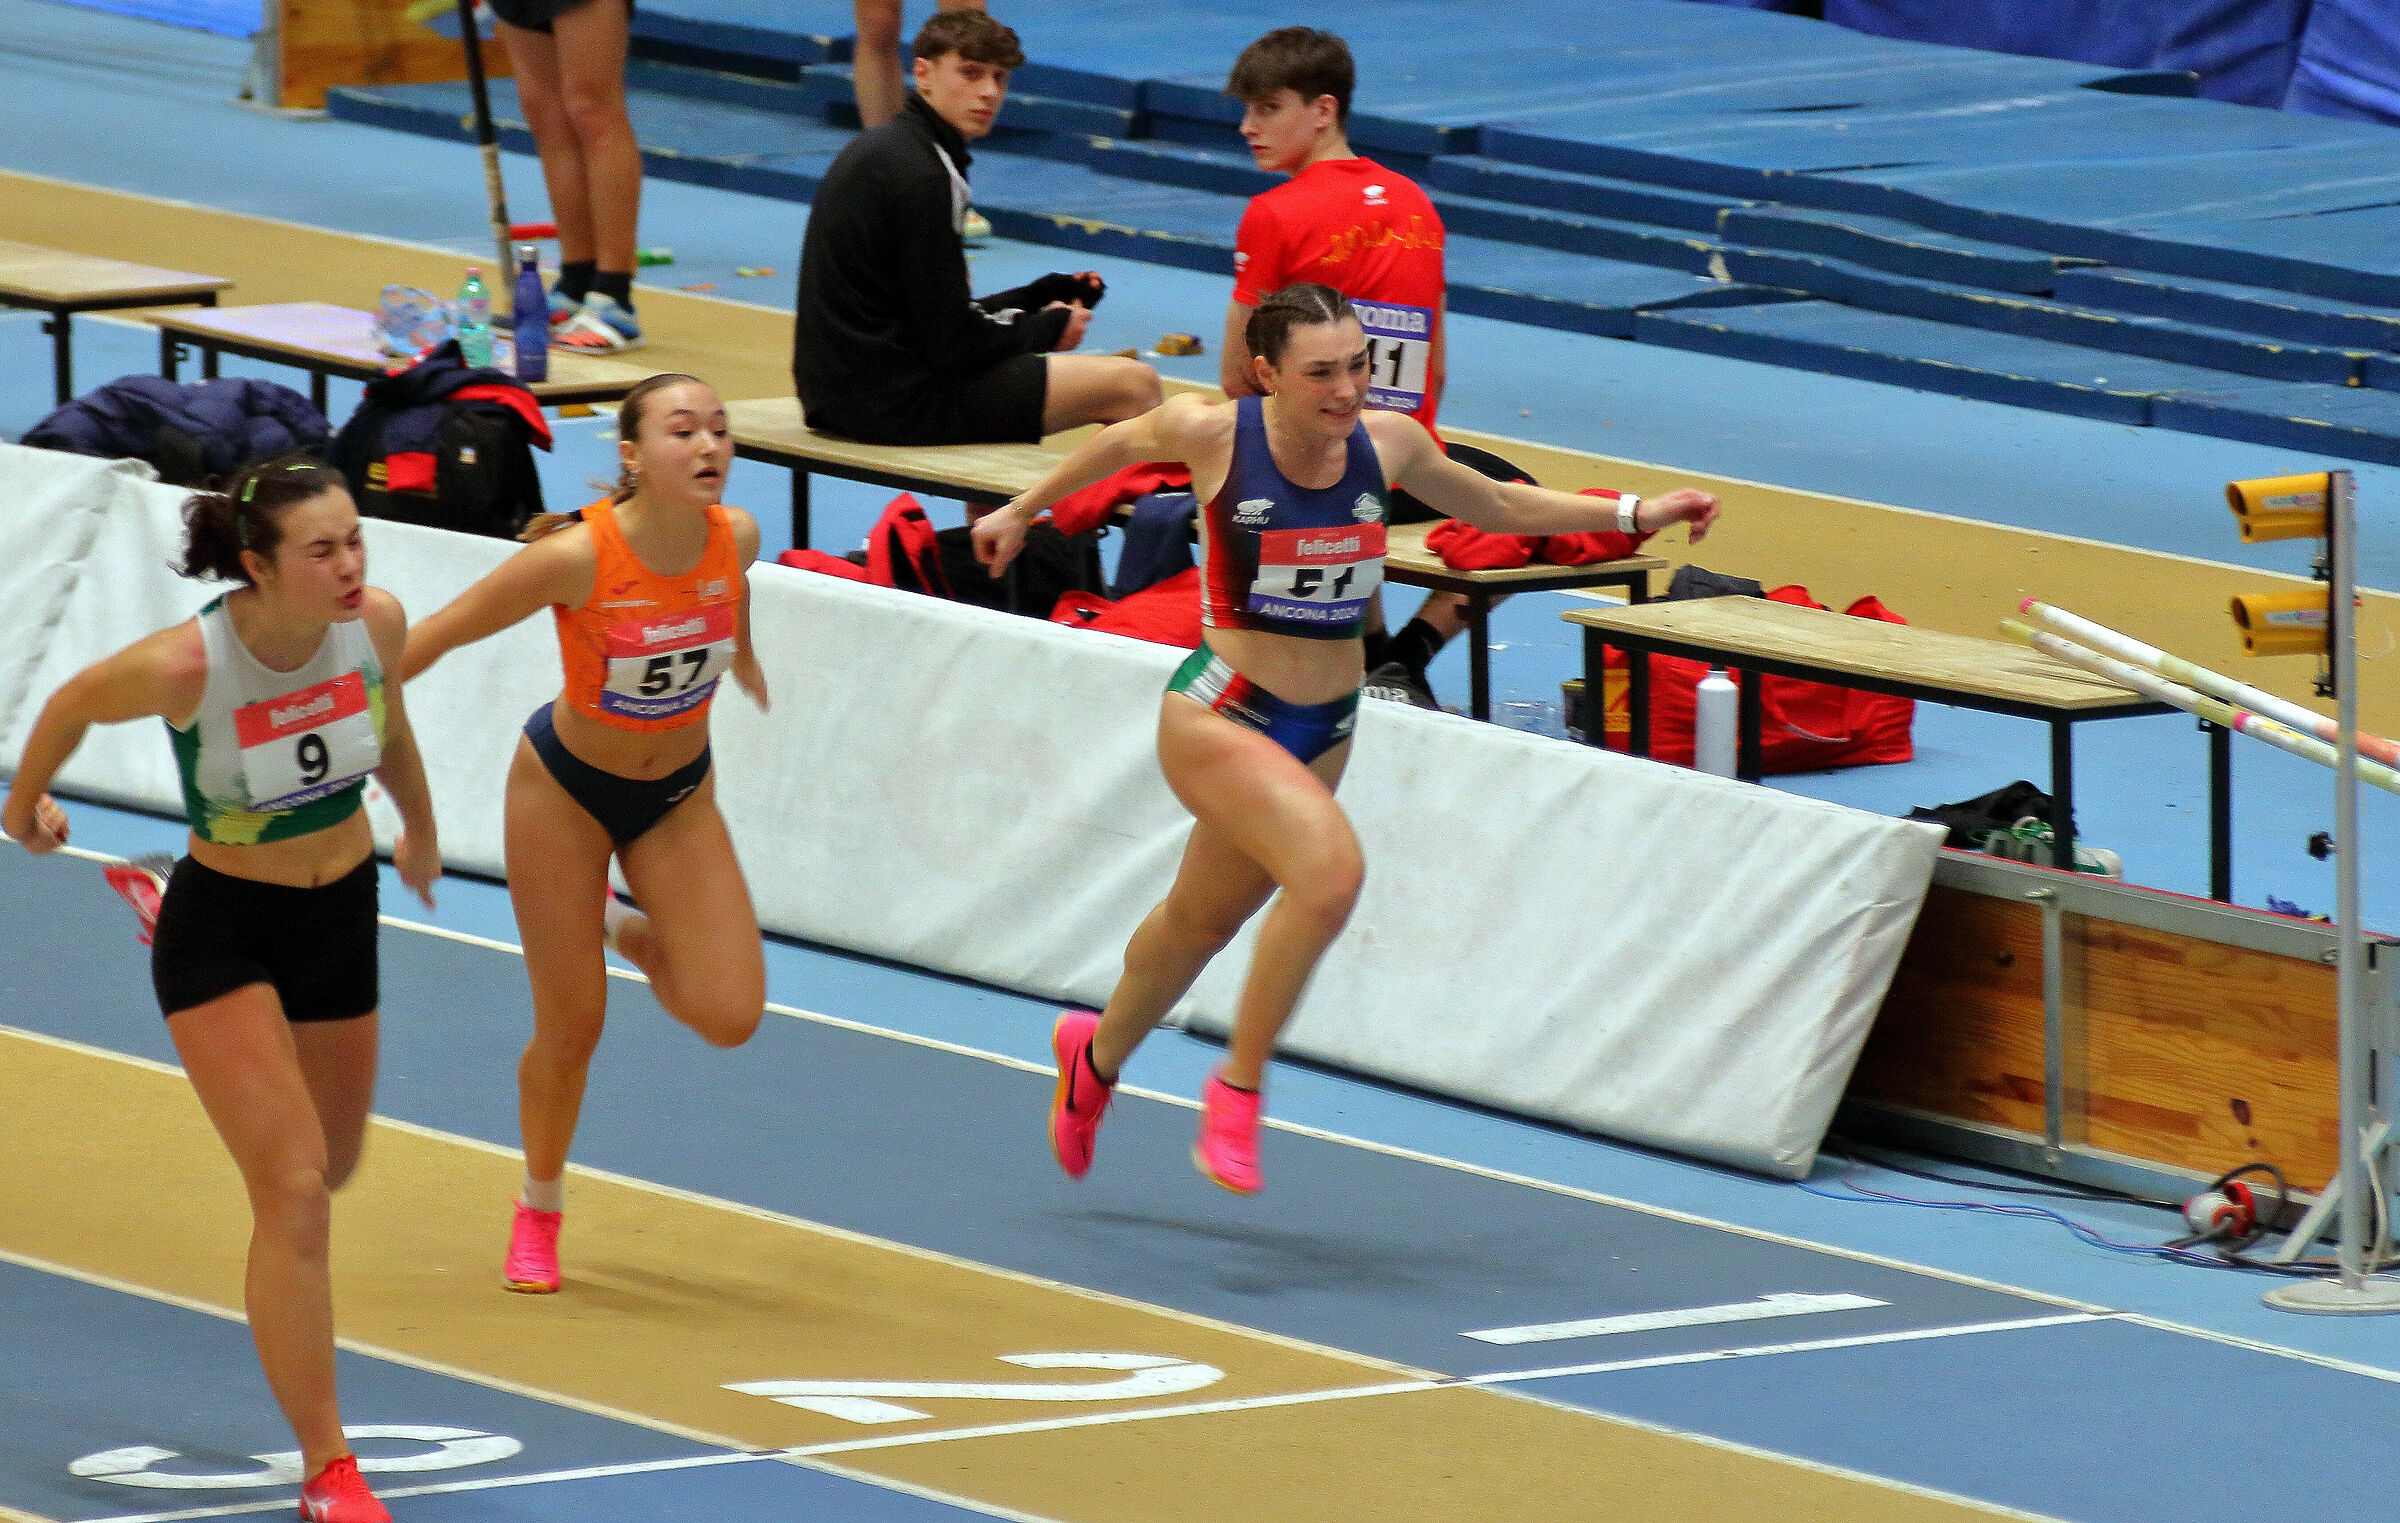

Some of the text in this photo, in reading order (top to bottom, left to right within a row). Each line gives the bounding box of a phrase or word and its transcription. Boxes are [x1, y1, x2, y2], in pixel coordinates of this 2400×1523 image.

[1296, 535, 1362, 557] felicetti
[1259, 602, 1362, 621] ANCONA 2024
[638, 648, 709, 697] 57
[297, 733, 329, 787] 9
[1461, 1291, 1893, 1345] 1
[721, 1351, 1225, 1425] 2
[69, 1424, 523, 1490] 3
